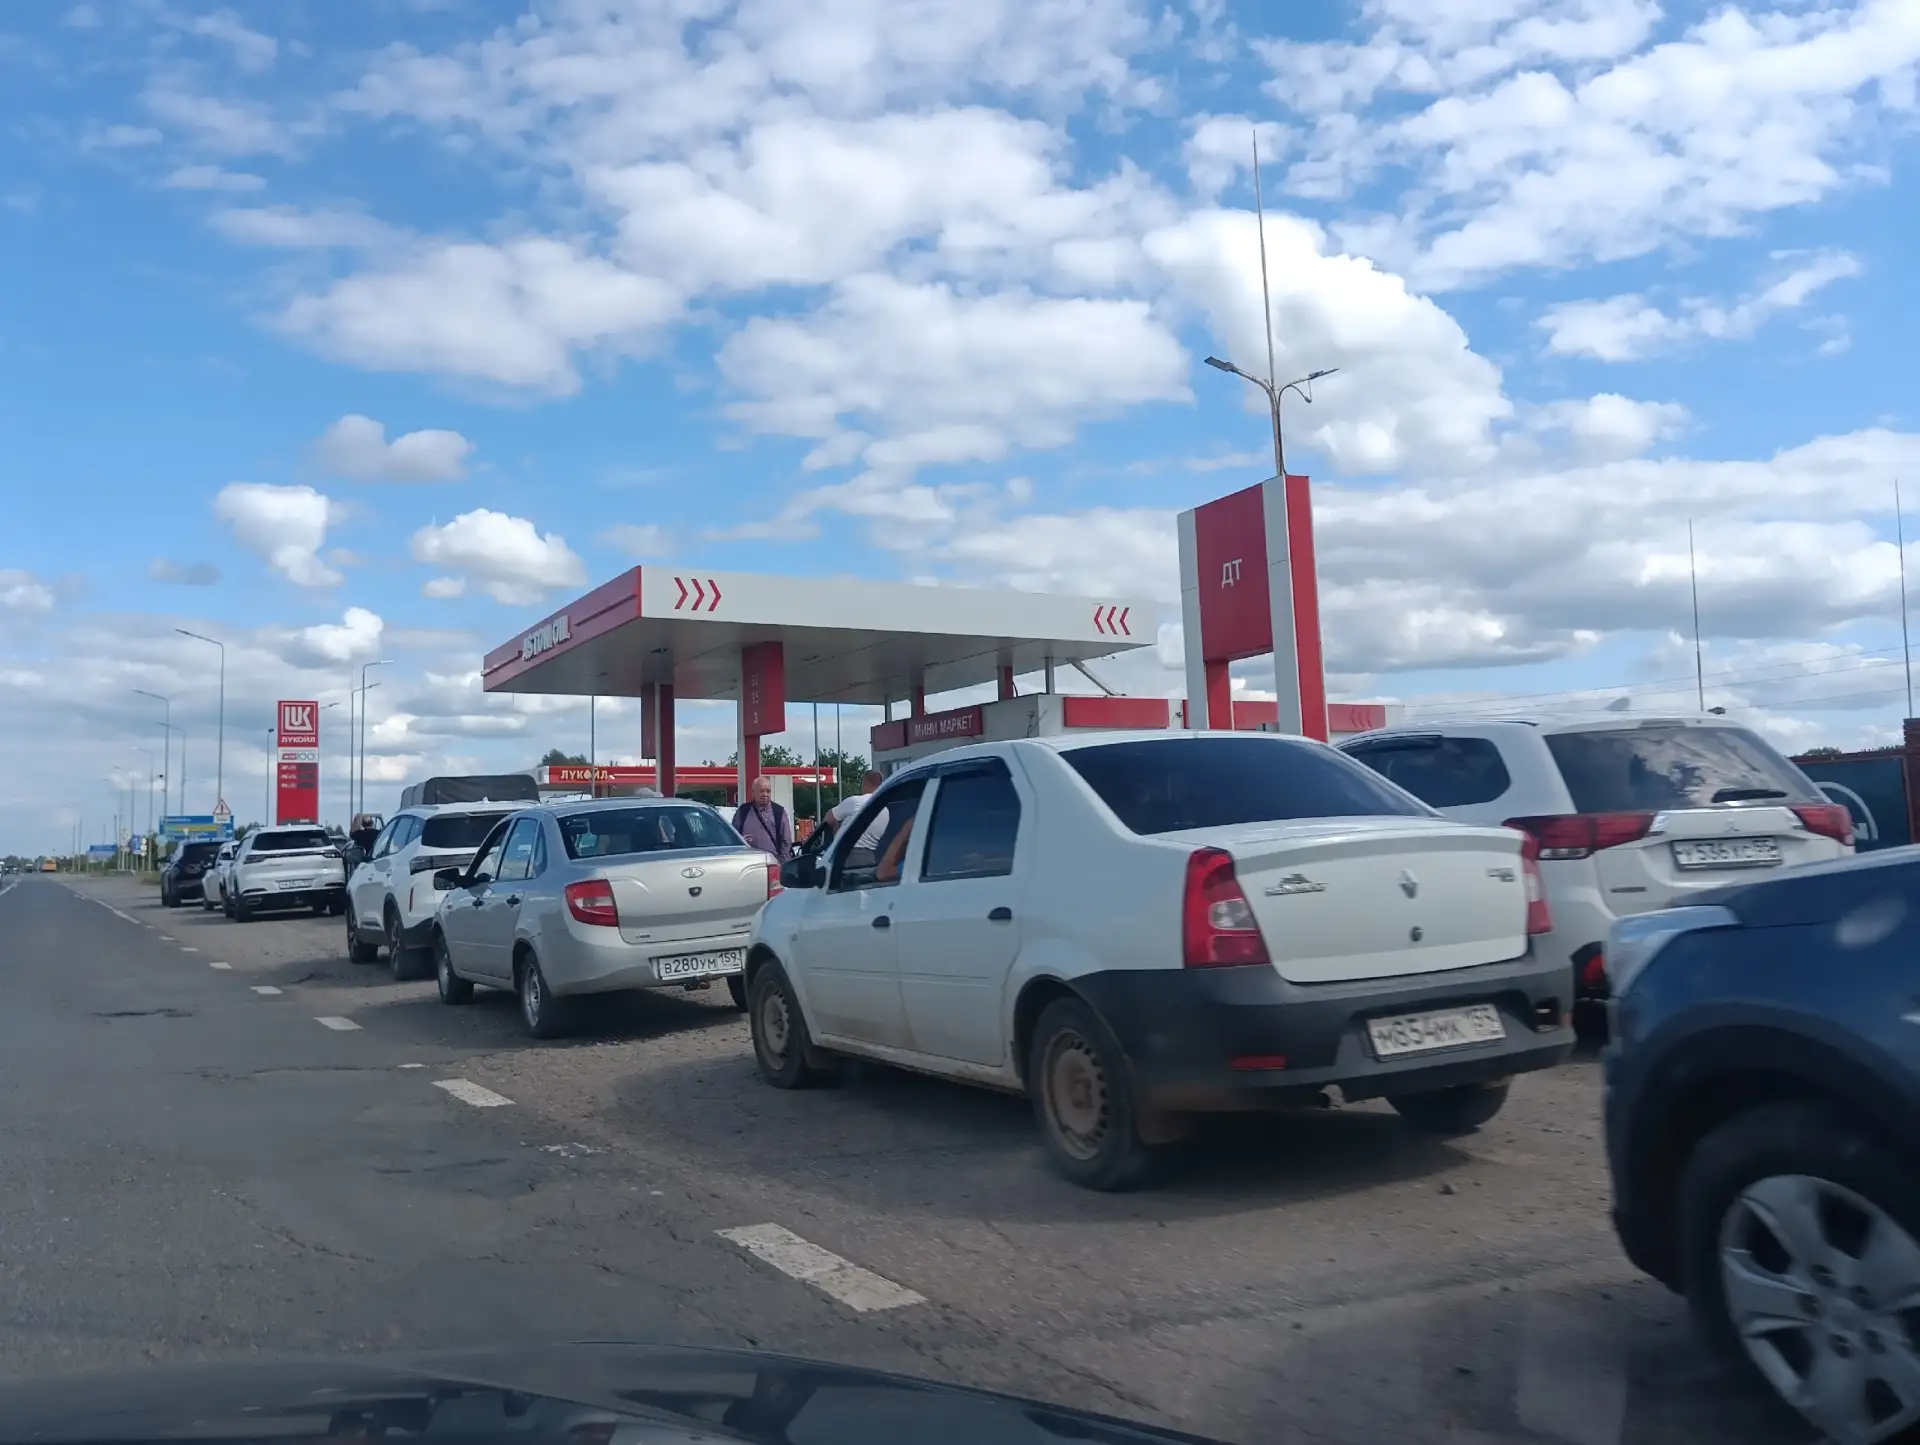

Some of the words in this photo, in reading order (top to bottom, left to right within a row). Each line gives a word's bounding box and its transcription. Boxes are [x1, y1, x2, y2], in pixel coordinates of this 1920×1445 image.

[1222, 558, 1242, 588] ДТ
[914, 722, 938, 738] МИНИ
[940, 714, 973, 734] МАРКЕТ
[281, 735, 316, 743] ЛУКОЙЛ
[560, 767, 608, 780] ЛУКОЙЛ
[664, 957, 717, 974] В280УМ
[719, 951, 737, 964] 159
